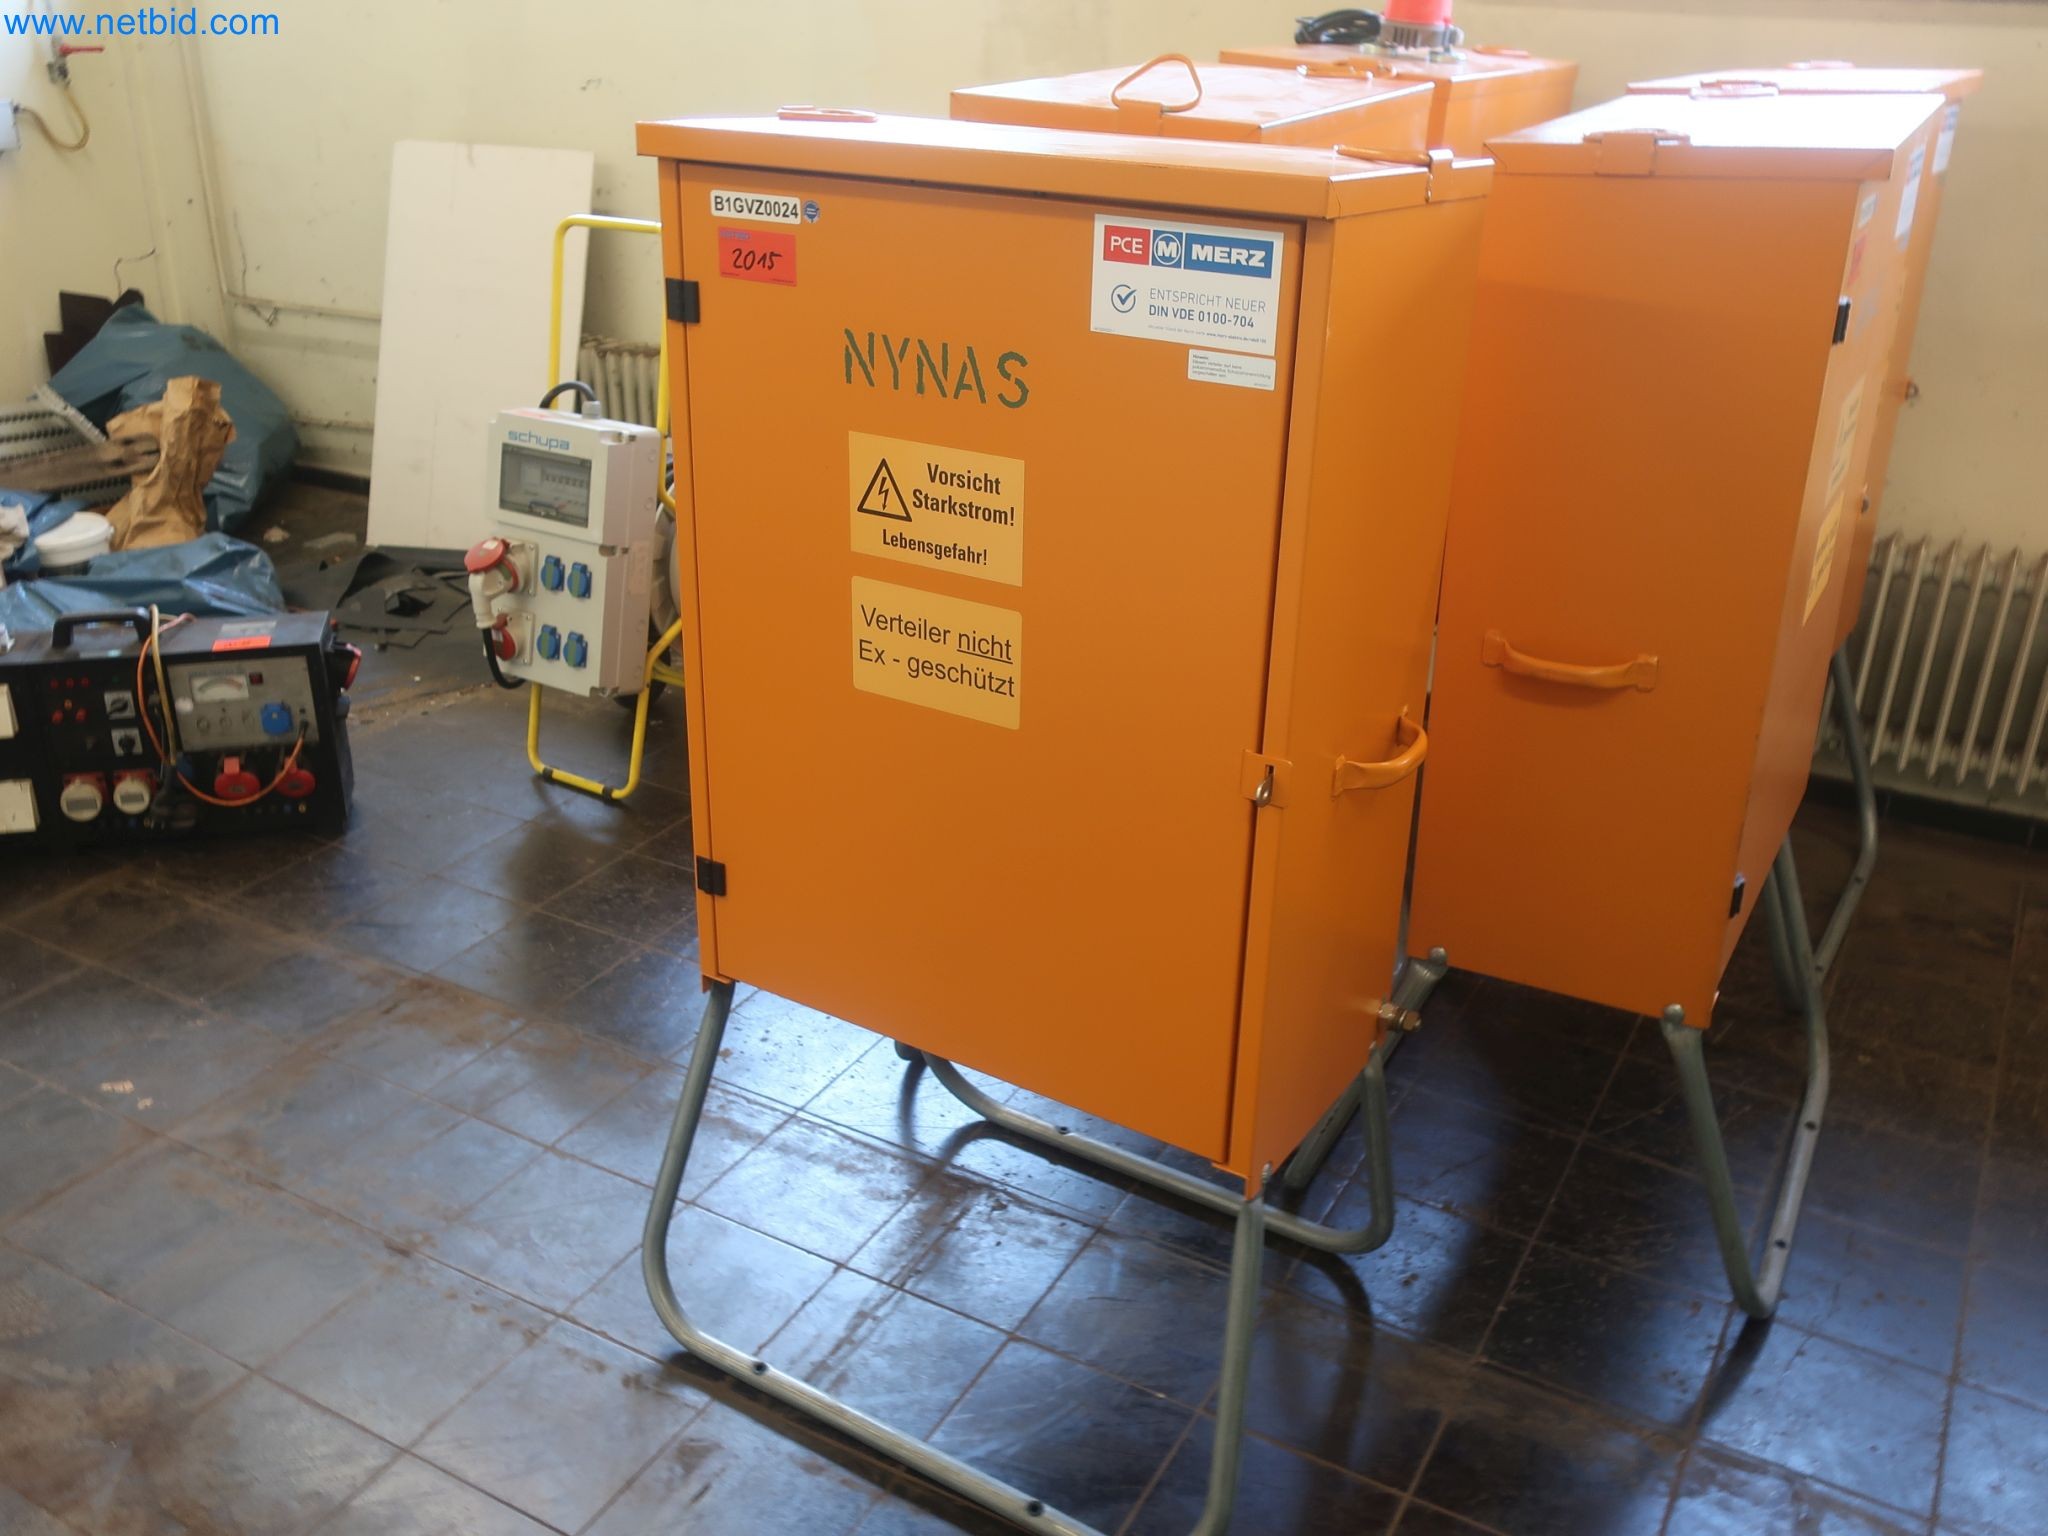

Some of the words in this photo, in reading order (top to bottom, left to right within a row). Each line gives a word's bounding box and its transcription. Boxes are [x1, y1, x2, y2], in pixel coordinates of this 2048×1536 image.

[714, 195, 799, 219] B1GVZ0024
[732, 248, 783, 271] 2015
[1110, 236, 1143, 255] PCE
[1156, 240, 1177, 258] M
[1191, 243, 1266, 268] MERZ
[1149, 288, 1222, 309] ENTSPRICHT
[1225, 297, 1266, 313] NEUER
[1149, 304, 1168, 319] DIN
[1172, 307, 1195, 321] VDE
[1198, 311, 1255, 329] 0100-704
[844, 328, 1030, 409] NYNAS
[508, 430, 570, 451] schupa
[926, 462, 1001, 496] Vorsicht
[912, 488, 1015, 527] Starkstrom!
[882, 528, 988, 566] Lebensgefahr!
[860, 604, 952, 646] Verteiler
[957, 630, 1013, 663] nicht
[859, 638, 886, 666] Ex
[907, 655, 1015, 698] geschützt
